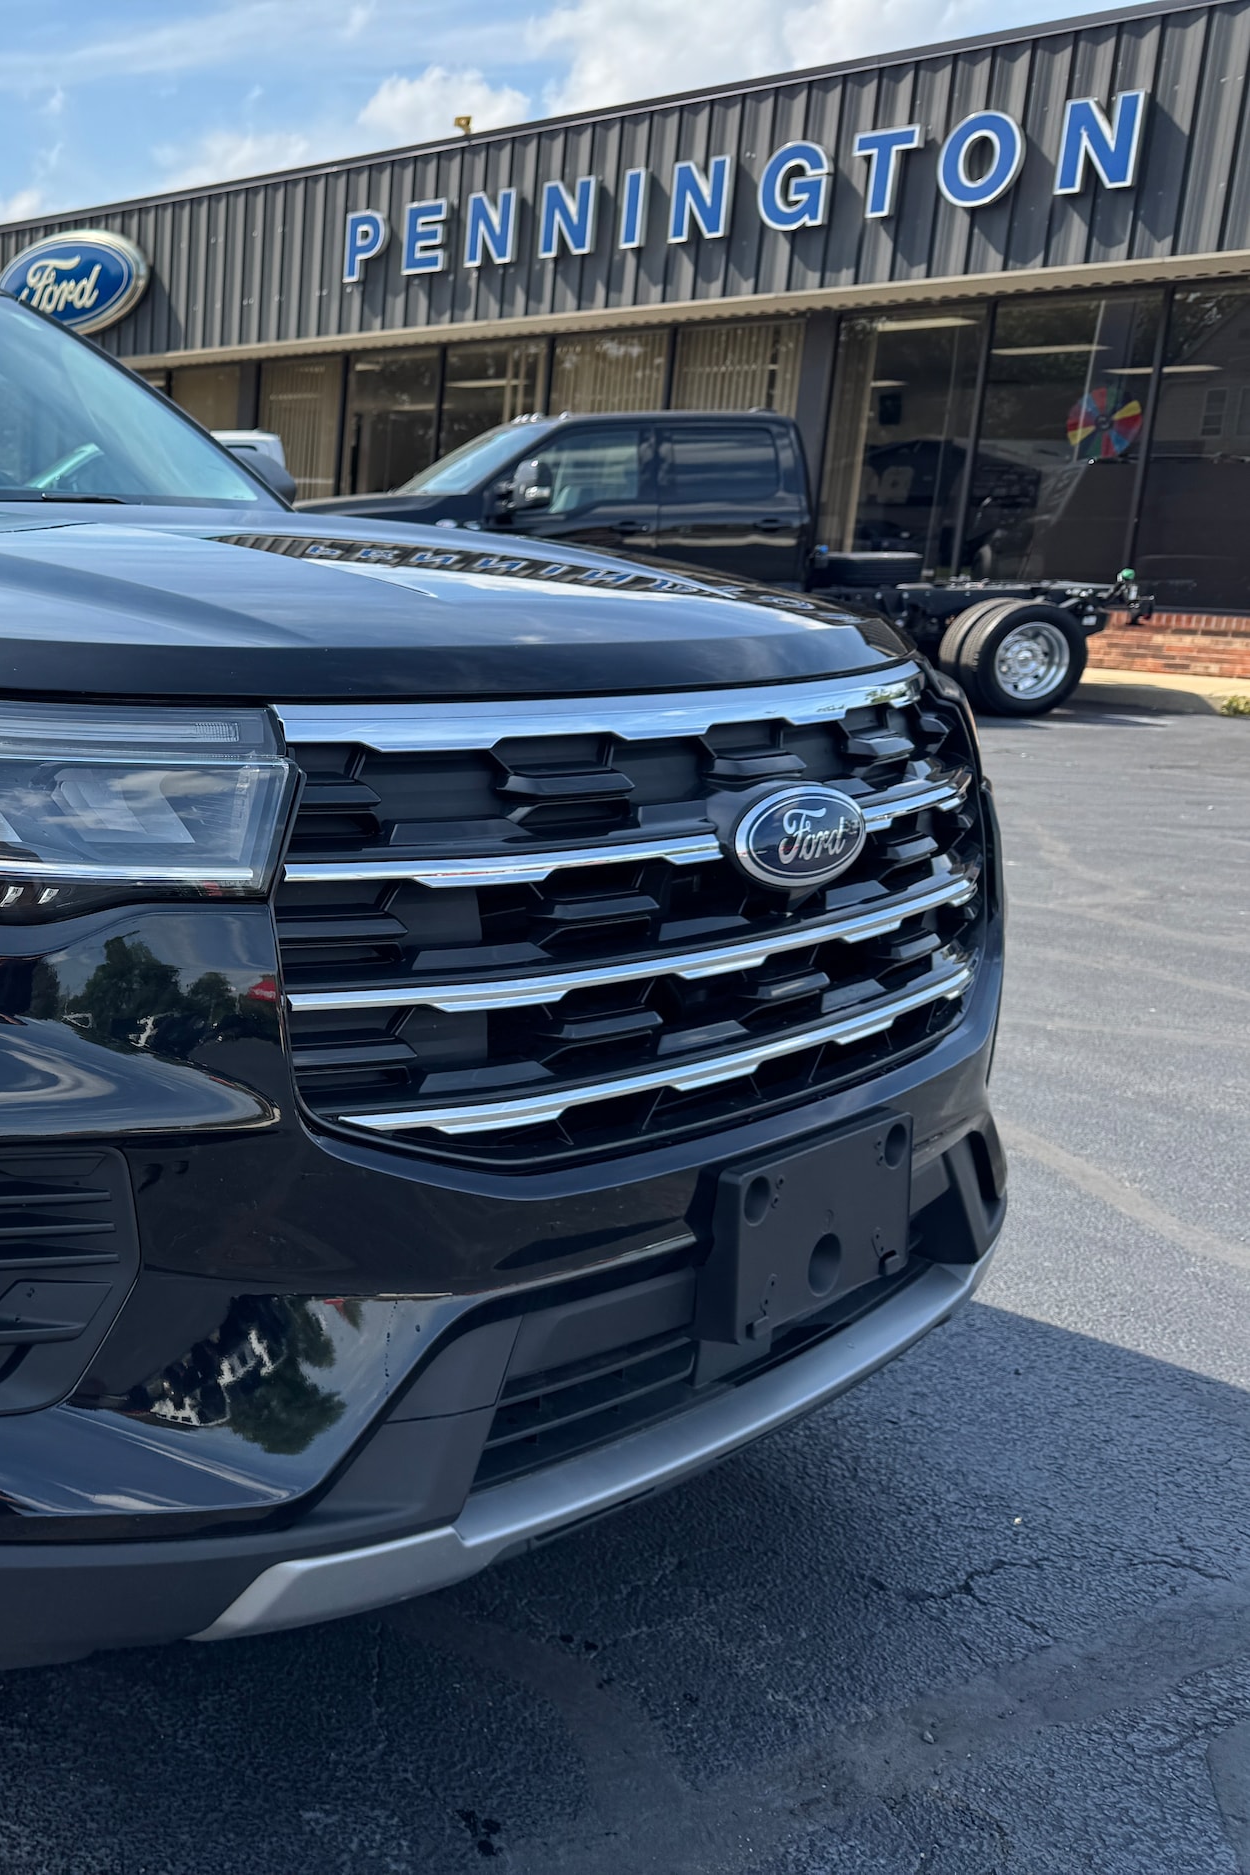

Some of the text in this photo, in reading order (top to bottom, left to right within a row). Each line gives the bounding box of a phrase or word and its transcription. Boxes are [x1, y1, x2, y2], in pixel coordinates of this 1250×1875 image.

[342, 88, 1147, 284] PENNINGTON
[17, 253, 102, 314] Ford
[778, 807, 846, 865] Ford
